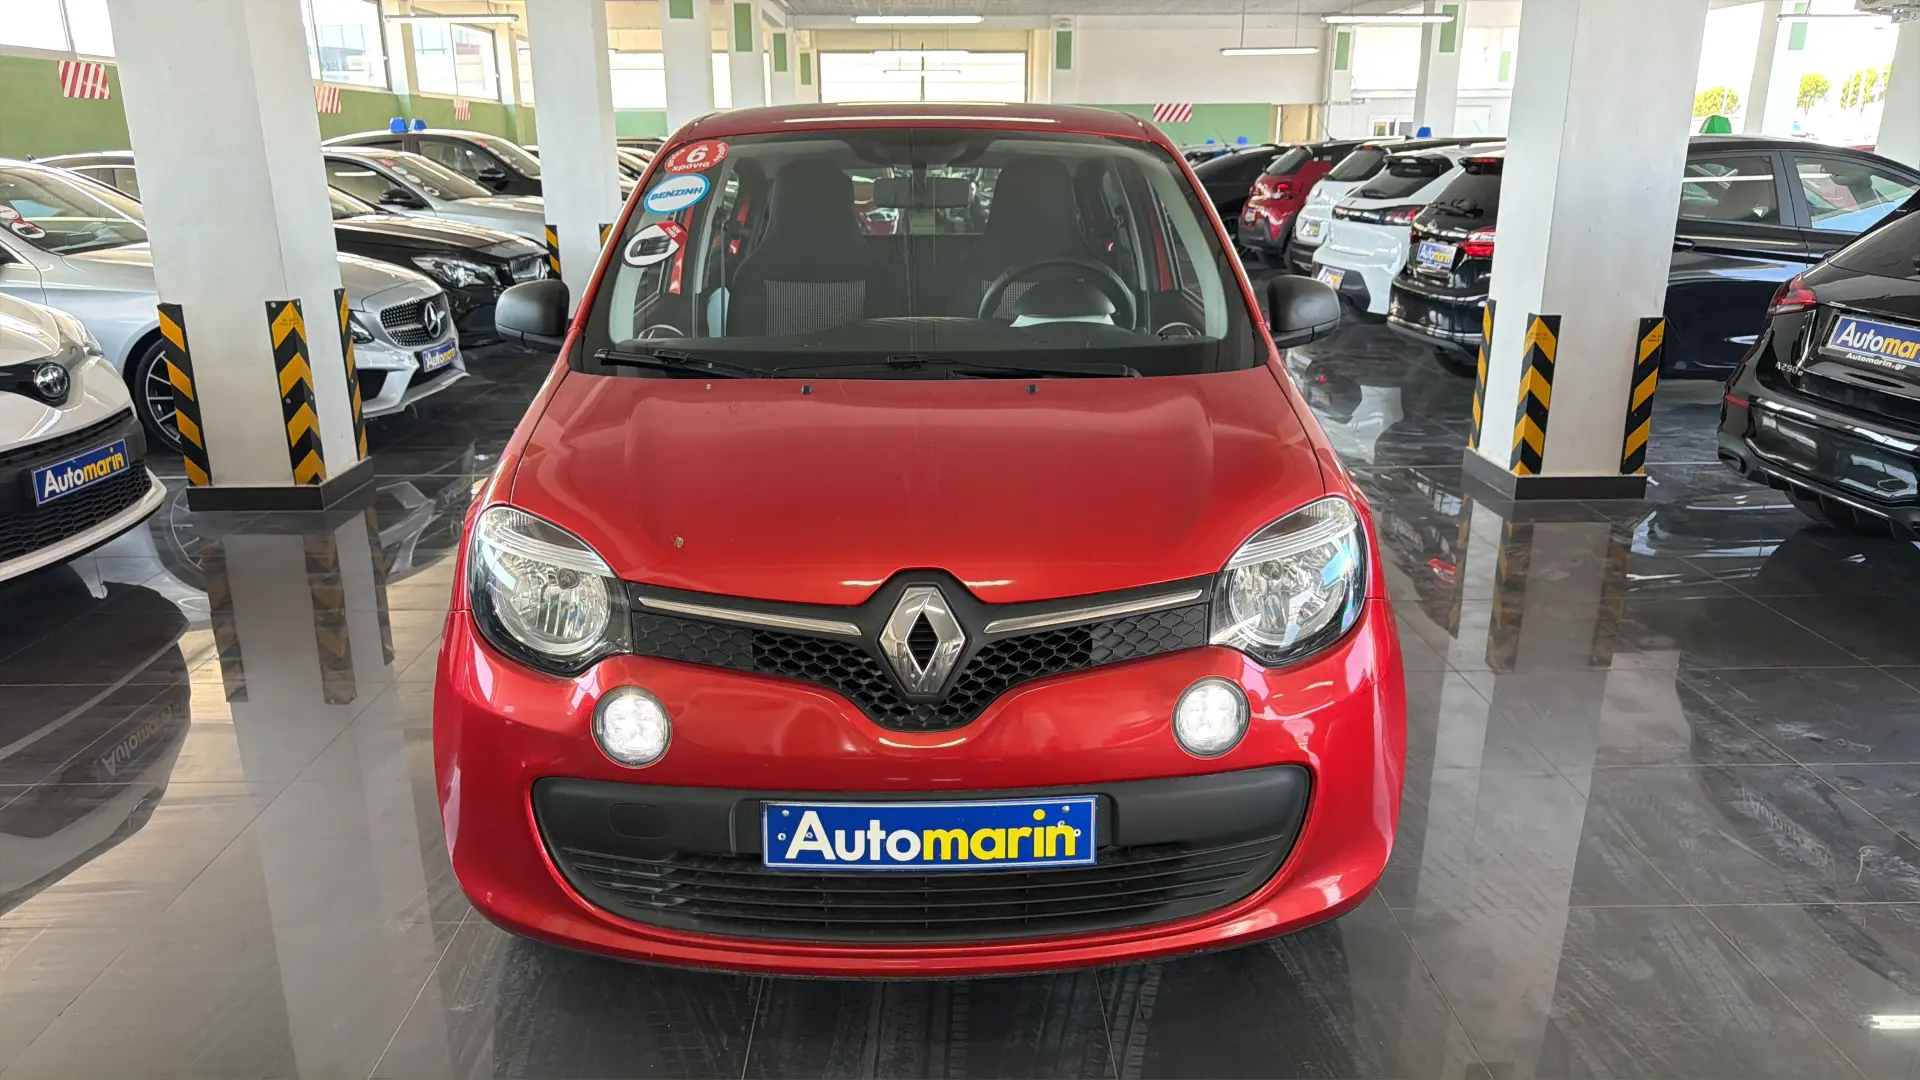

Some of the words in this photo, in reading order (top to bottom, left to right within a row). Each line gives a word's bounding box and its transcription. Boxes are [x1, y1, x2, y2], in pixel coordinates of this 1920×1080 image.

[687, 146, 709, 163] 6
[1836, 321, 1920, 360] Automar
[1845, 352, 1907, 371] Automarin.gr
[44, 446, 125, 498] Automarin
[784, 808, 1077, 862] Automarin
